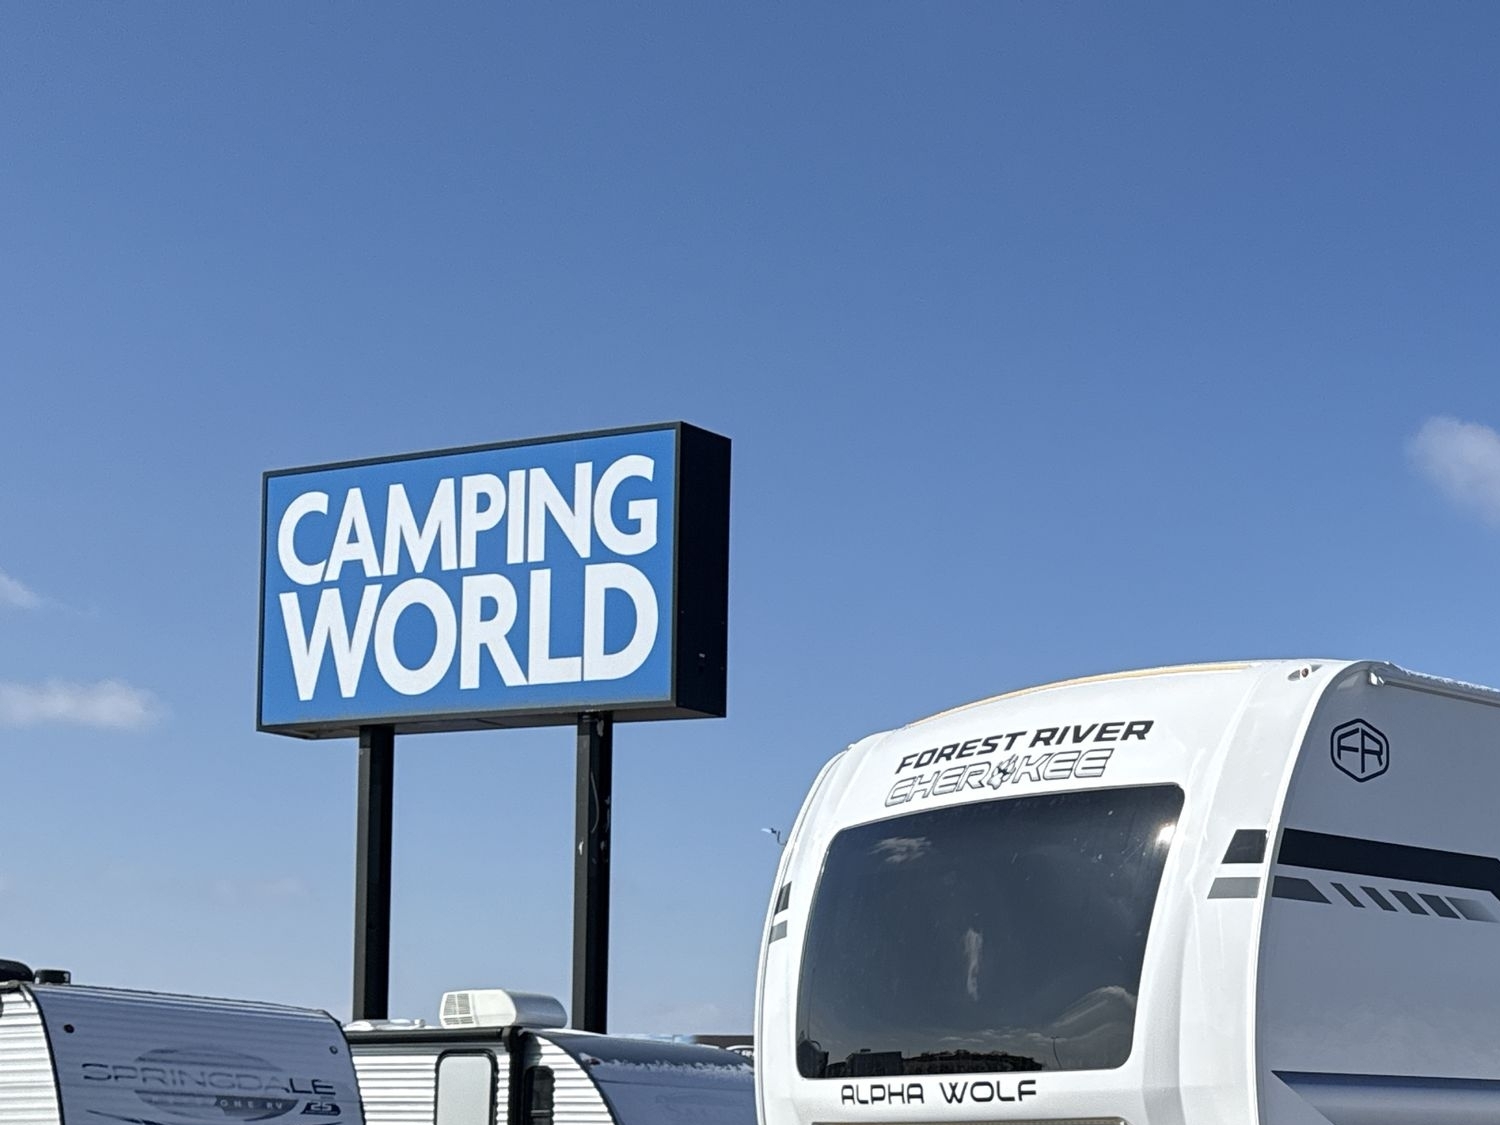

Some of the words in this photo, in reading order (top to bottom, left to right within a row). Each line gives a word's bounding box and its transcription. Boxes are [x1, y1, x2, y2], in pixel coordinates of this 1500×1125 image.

[278, 455, 658, 585] CAMPING
[279, 562, 659, 701] WORLD
[895, 731, 1027, 774] FOREST
[1028, 720, 1154, 748] RIVER
[81, 1063, 336, 1096] SPRINGDALE
[841, 1083, 924, 1105] ALPHA
[939, 1079, 1037, 1104] WOLF
